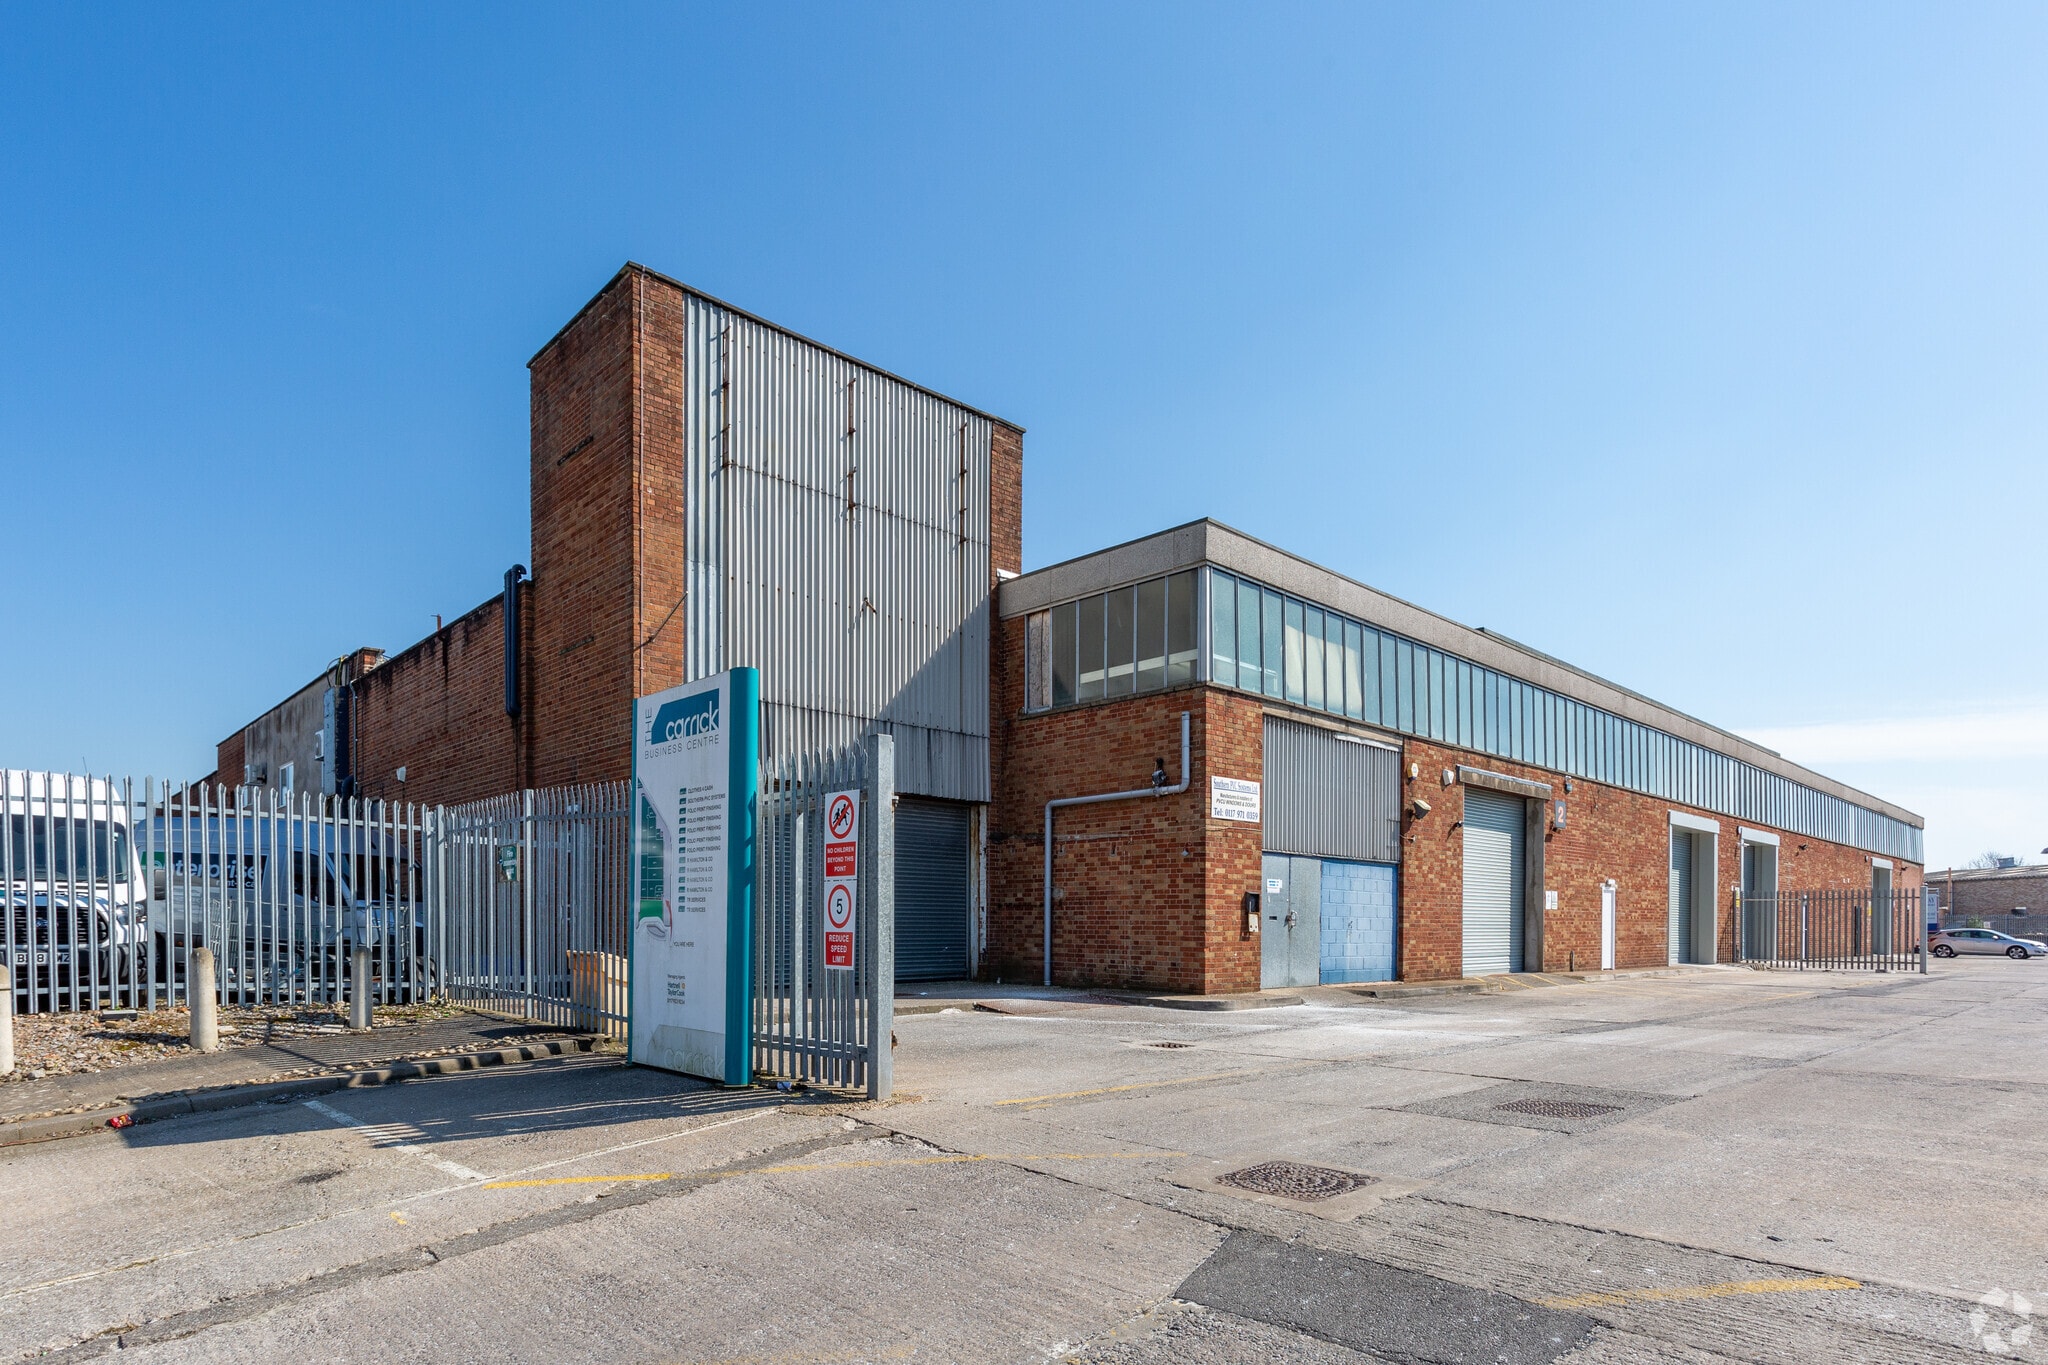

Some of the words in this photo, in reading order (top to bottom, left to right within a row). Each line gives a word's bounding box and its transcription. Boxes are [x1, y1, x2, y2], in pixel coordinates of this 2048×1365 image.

[665, 700, 720, 741] carrick
[644, 743, 682, 759] BUSINESS
[687, 734, 720, 750] CENTRE
[1558, 806, 1564, 823] 2
[152, 860, 262, 879] terprise
[836, 899, 843, 914] 5
[828, 934, 849, 942] REDUCE
[17, 954, 45, 963] B8
[832, 955, 845, 963] LIMIT
